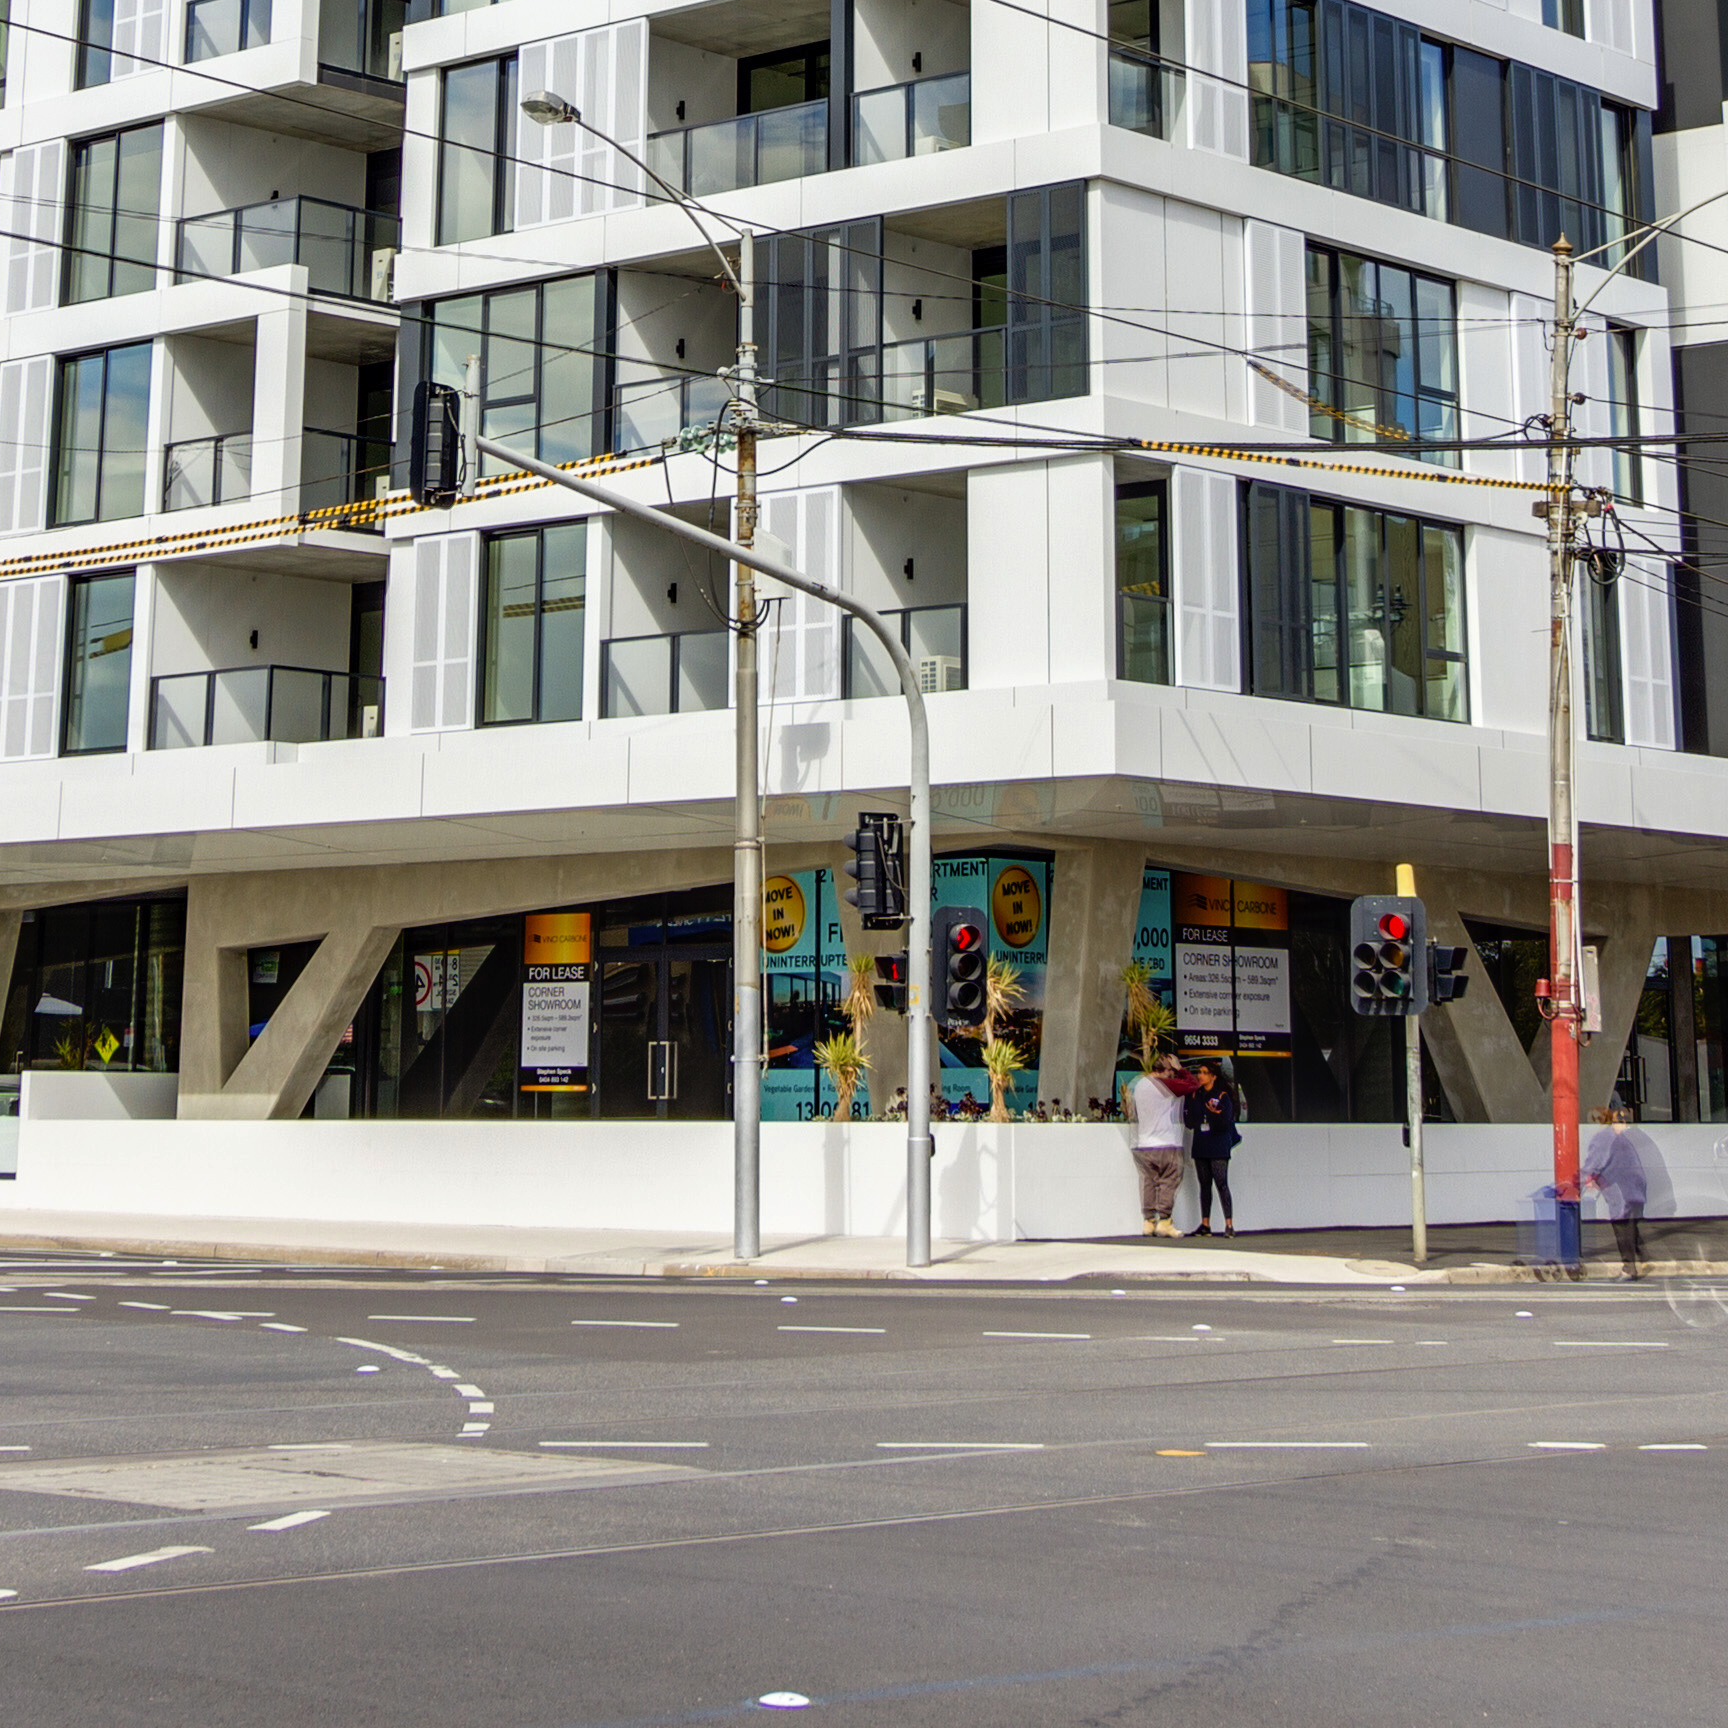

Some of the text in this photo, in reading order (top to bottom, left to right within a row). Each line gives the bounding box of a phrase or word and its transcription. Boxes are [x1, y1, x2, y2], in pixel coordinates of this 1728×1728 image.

[1002, 880, 1030, 896] MOVE
[773, 907, 784, 921] IN
[1013, 900, 1023, 915] IN
[1237, 899, 1277, 915] CARBONE
[766, 924, 795, 942] NOW!
[1006, 919, 1033, 935] NOW!
[559, 934, 588, 943] CARBONE
[1133, 926, 1170, 951] ,000
[1182, 927, 1228, 943] FOR LEASE
[1183, 952, 1279, 969] CORNER SHOWROOM
[529, 966, 585, 980] FOR LEASE
[528, 986, 565, 998] CORNER
[1189, 988, 1218, 1000] Extensive
[1243, 992, 1270, 1003] exposure
[528, 998, 582, 1011] SHOWROOM
[1189, 1005, 1199, 1015] On
[1200, 1006, 1212, 1016] site
[1184, 1035, 1219, 1047] 9654 3333
[763, 1084, 792, 1095] Vegetable
